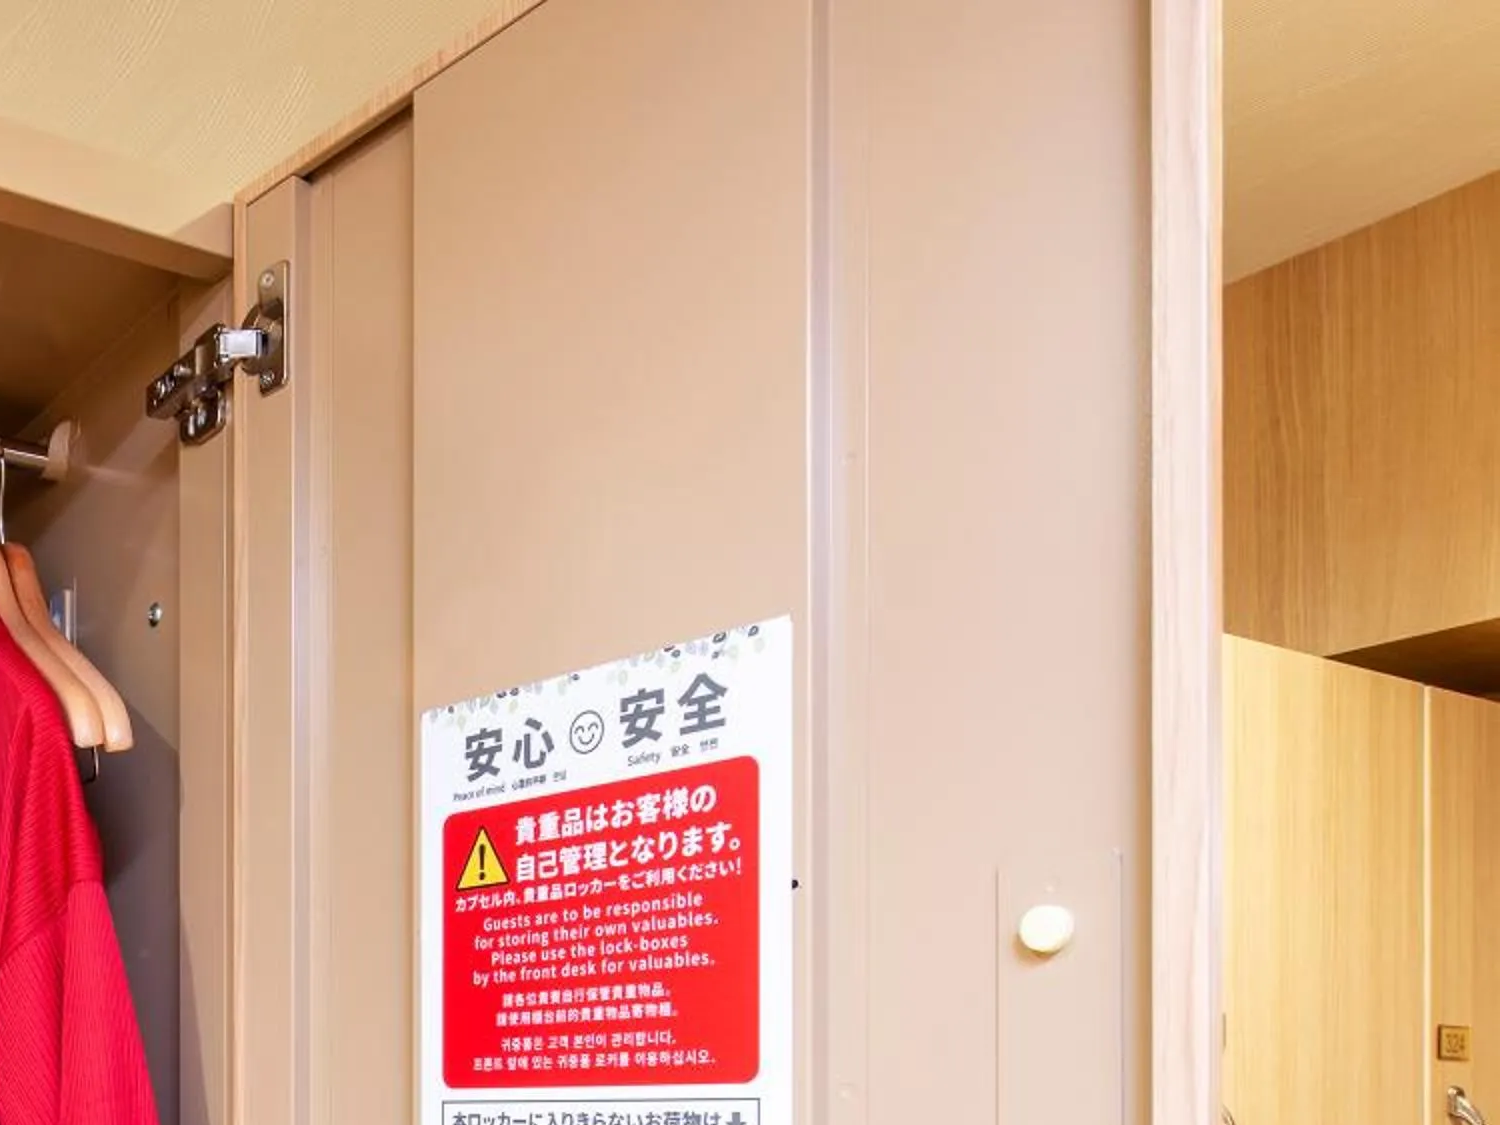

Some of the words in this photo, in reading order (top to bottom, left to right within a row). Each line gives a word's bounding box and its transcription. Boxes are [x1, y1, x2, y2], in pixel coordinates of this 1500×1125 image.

[464, 717, 555, 782] 安心
[619, 672, 729, 749] 安全
[627, 748, 660, 769] Safety
[515, 784, 717, 846] 貴重品はお客様の
[516, 818, 741, 884] 自己管理となります。
[474, 935, 493, 950] for
[497, 930, 548, 951] storing
[553, 923, 589, 942] their
[595, 923, 626, 938] own
[631, 908, 719, 934] valuables.
[483, 912, 530, 932] Guests
[535, 912, 557, 926] are
[562, 907, 578, 922] to
[582, 903, 600, 920] be
[605, 890, 702, 921] responsible
[472, 970, 488, 986] by
[493, 967, 516, 983] the
[519, 963, 557, 981] front
[561, 959, 596, 977] desk
[600, 957, 623, 974] for
[628, 948, 715, 972] valuables.
[490, 947, 536, 966] Please
[541, 947, 566, 961] use
[570, 941, 595, 959] the
[600, 931, 688, 956] lock-boxes
